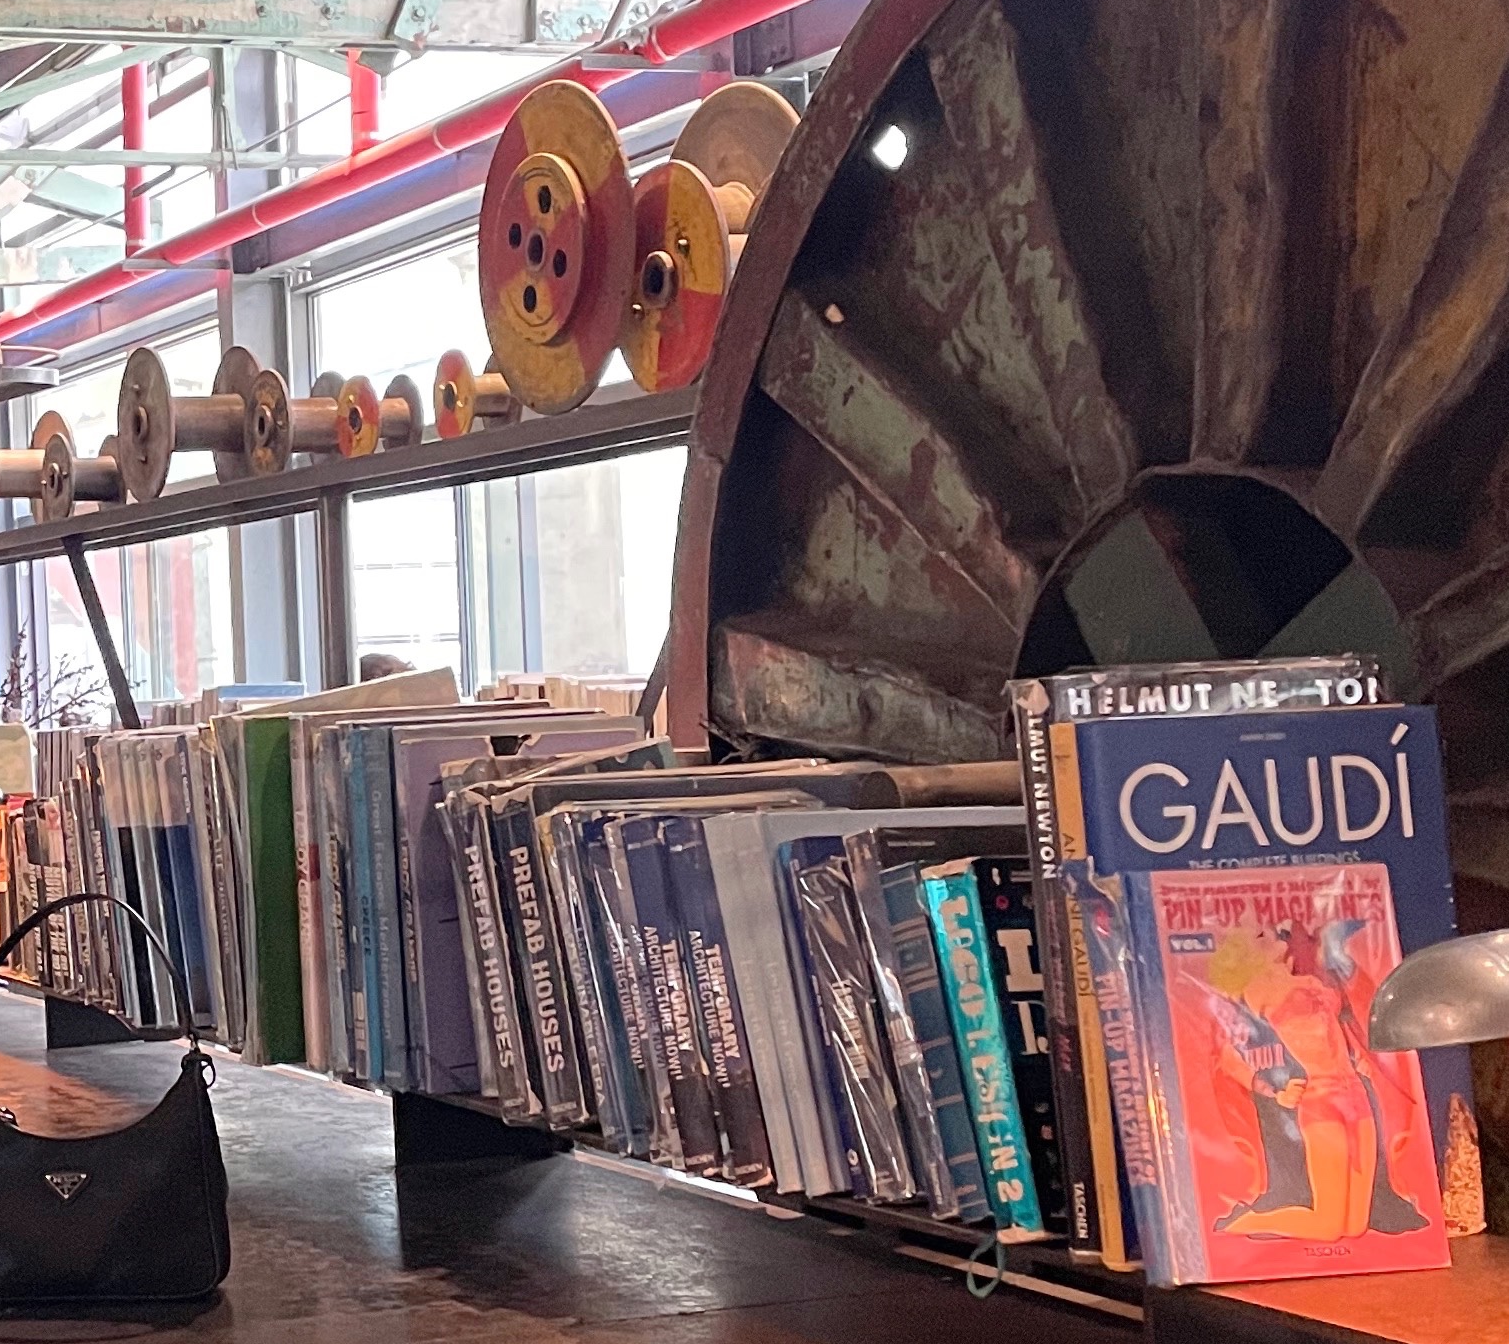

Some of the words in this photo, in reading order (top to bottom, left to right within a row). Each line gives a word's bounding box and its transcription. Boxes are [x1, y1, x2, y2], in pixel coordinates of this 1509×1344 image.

[1027, 710, 1044, 774] LMUT
[1067, 683, 1212, 715] HELMUT
[1230, 677, 1379, 707] NETO
[1033, 782, 1057, 879] NEWTON
[1119, 723, 1414, 853] GAUDÍ
[370, 790, 384, 834] Great
[377, 916, 396, 1039] Mediterranean
[463, 845, 495, 952] PREFAB
[483, 958, 514, 1068] HOUSES
[509, 846, 546, 955] PREFAB
[531, 961, 565, 1074] HOUSES
[1252, 893, 1386, 930] MAGANES
[623, 937, 649, 1040] EMPORARY
[644, 926, 674, 1034] ARCHITECTURE
[663, 939, 694, 1051] TEMPORARY
[689, 930, 721, 1042] ARCHITECTURE
[706, 943, 740, 1058] TEMPORARY
[589, 1060, 607, 1107] ERA
[996, 1179, 1024, 1204] 2
